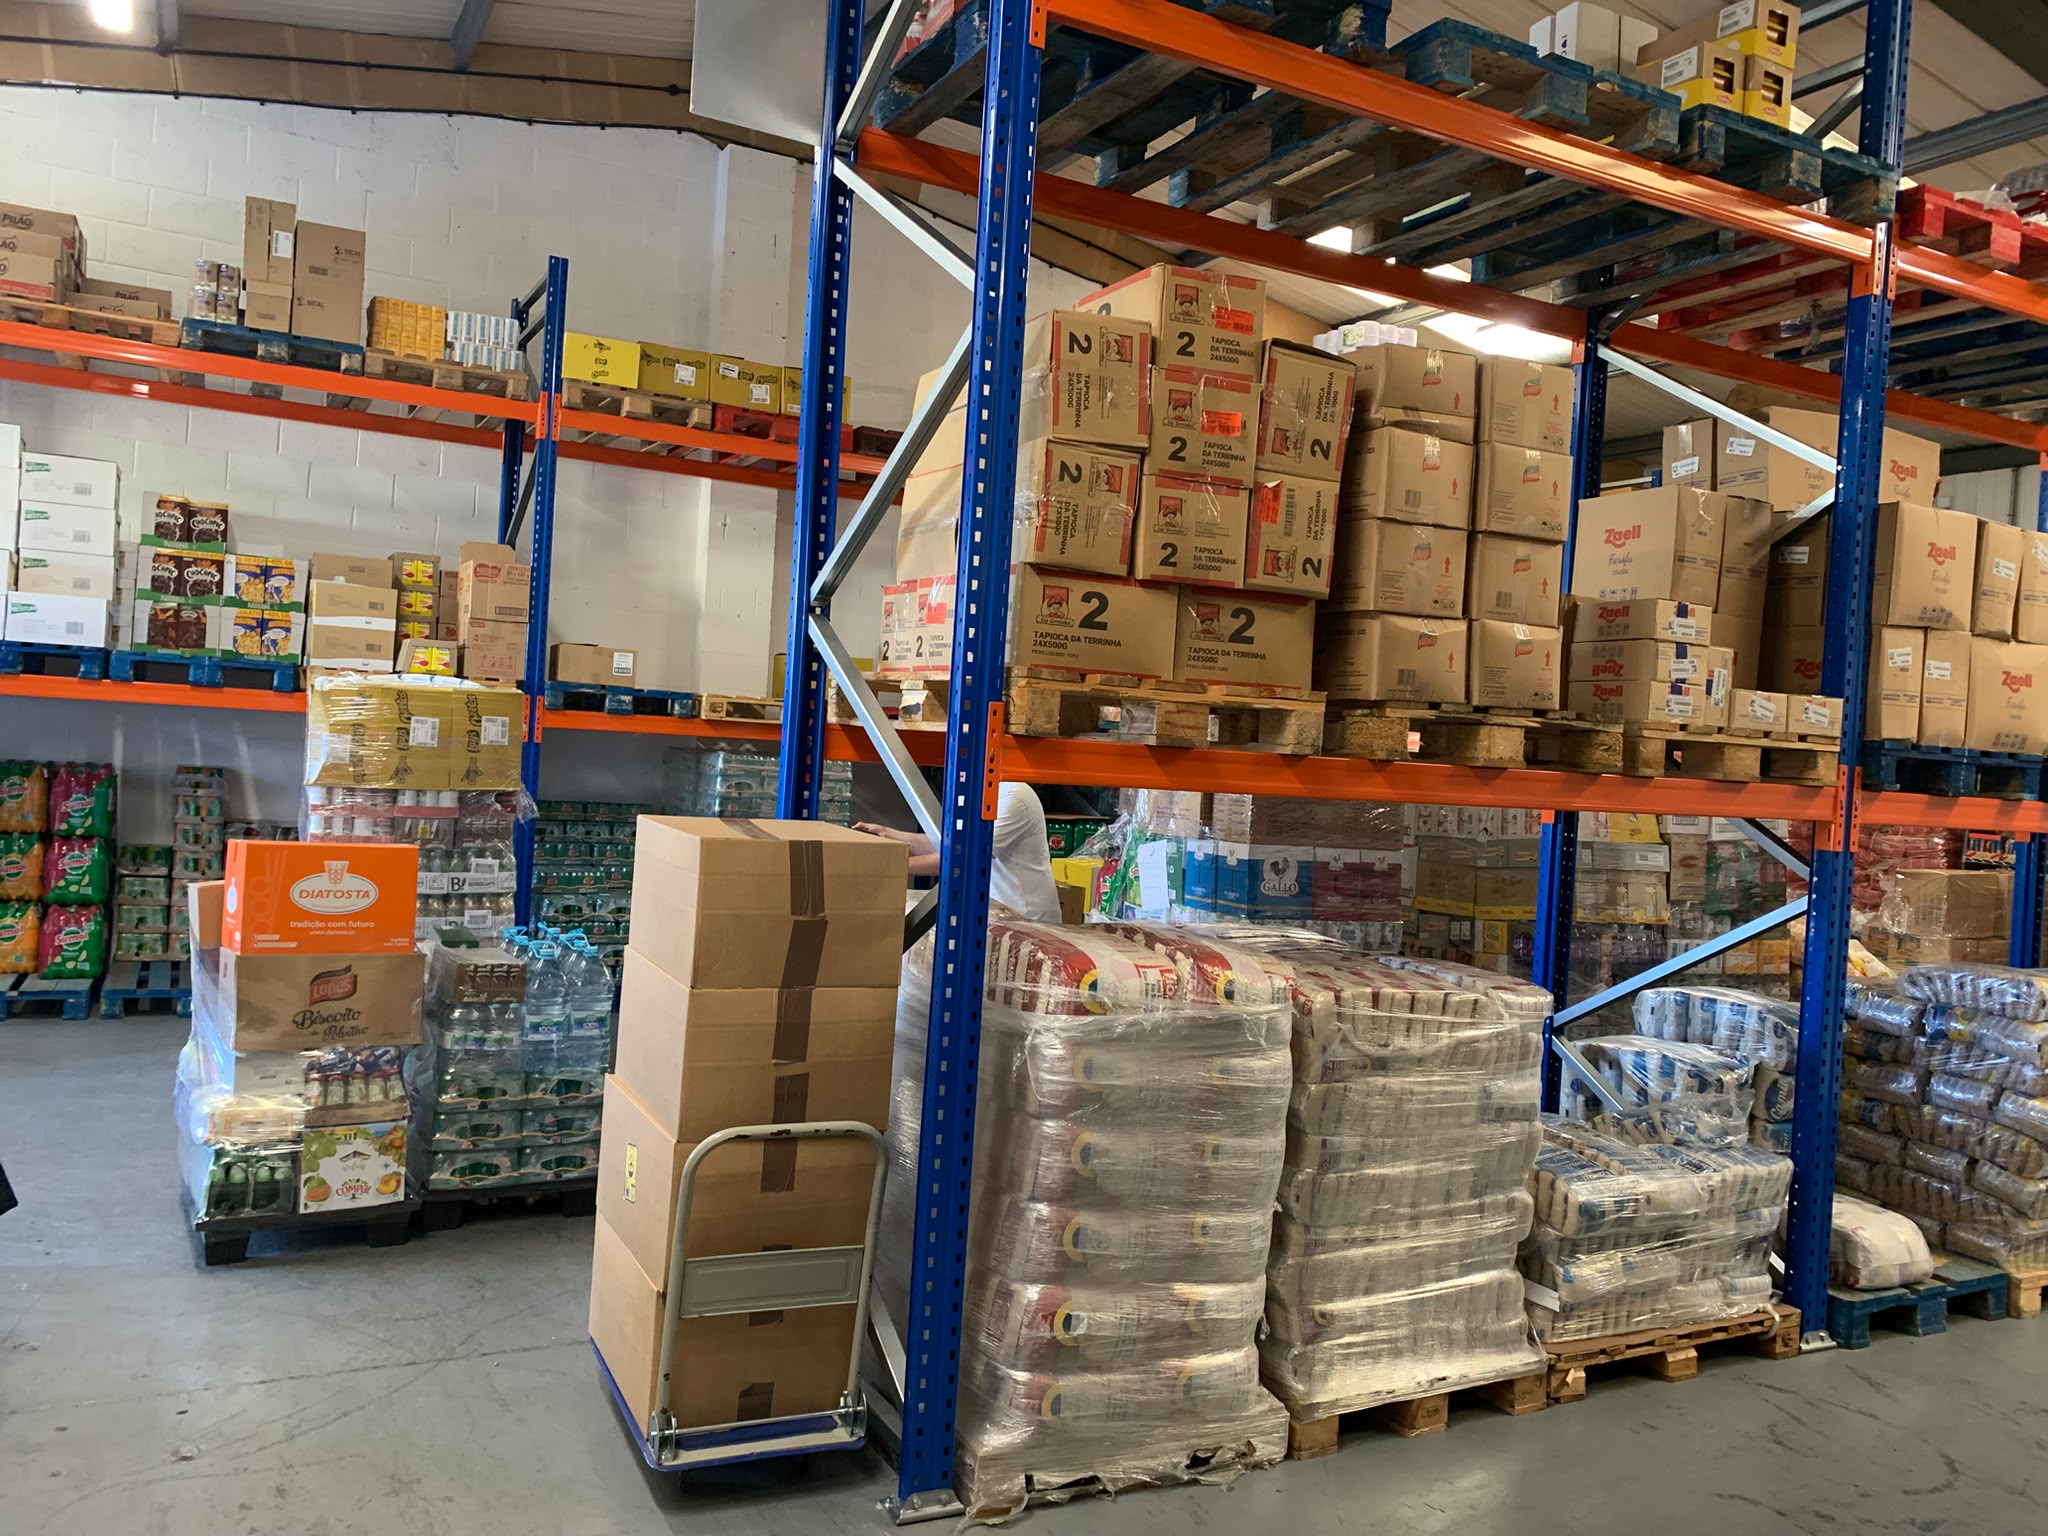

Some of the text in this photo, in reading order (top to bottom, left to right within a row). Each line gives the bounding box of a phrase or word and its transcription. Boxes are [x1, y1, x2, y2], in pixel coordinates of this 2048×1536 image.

[1069, 331, 1092, 354] 2
[1176, 331, 1196, 357] 2
[1210, 345, 1220, 353] DA
[1211, 336, 1240, 347] TAPIOCA
[1076, 373, 1083, 385] DA
[1083, 374, 1091, 411] TAPIOCA
[1168, 436, 1187, 462] 2
[1202, 450, 1212, 458] DA
[1203, 441, 1232, 451] TAPIOCA
[1310, 439, 1331, 461] 2
[1059, 460, 1083, 484] 2
[1890, 459, 1918, 482] Zaell
[1069, 504, 1078, 539] TAPIOCA
[1604, 524, 1642, 549] Zaell
[1159, 542, 1178, 567] 2
[1193, 554, 1202, 562] DA
[1194, 546, 1223, 556] TAPIOCA
[1928, 542, 1956, 566] Zaell
[1302, 557, 1322, 578] 2
[1078, 590, 1109, 631] 2
[1598, 606, 1630, 624] Zaell
[1227, 607, 1255, 645] 2
[915, 635, 923, 657] 2
[1032, 640, 1067, 650] 24X500G
[1033, 631, 1121, 647] TAPIOCA DA TERRINHA
[882, 640, 890, 661] 2
[1187, 646, 1266, 660] TAPIOCA DA TERRINHA
[1592, 659, 1624, 677] Zaell
[2002, 671, 2033, 694] Zaell
[1592, 684, 1624, 702] Zaell
[61, 798, 94, 813] Sumol
[58, 855, 91, 870] Sumol
[298, 889, 370, 900] DIATOSTA
[1263, 881, 1297, 893] GALLO
[290, 920, 326, 929] tradição
[348, 920, 375, 928] futuro
[55, 931, 88, 946] Sumol
[292, 1007, 363, 1030] Biscoito
[1770, 1078, 1791, 1120] Camil
